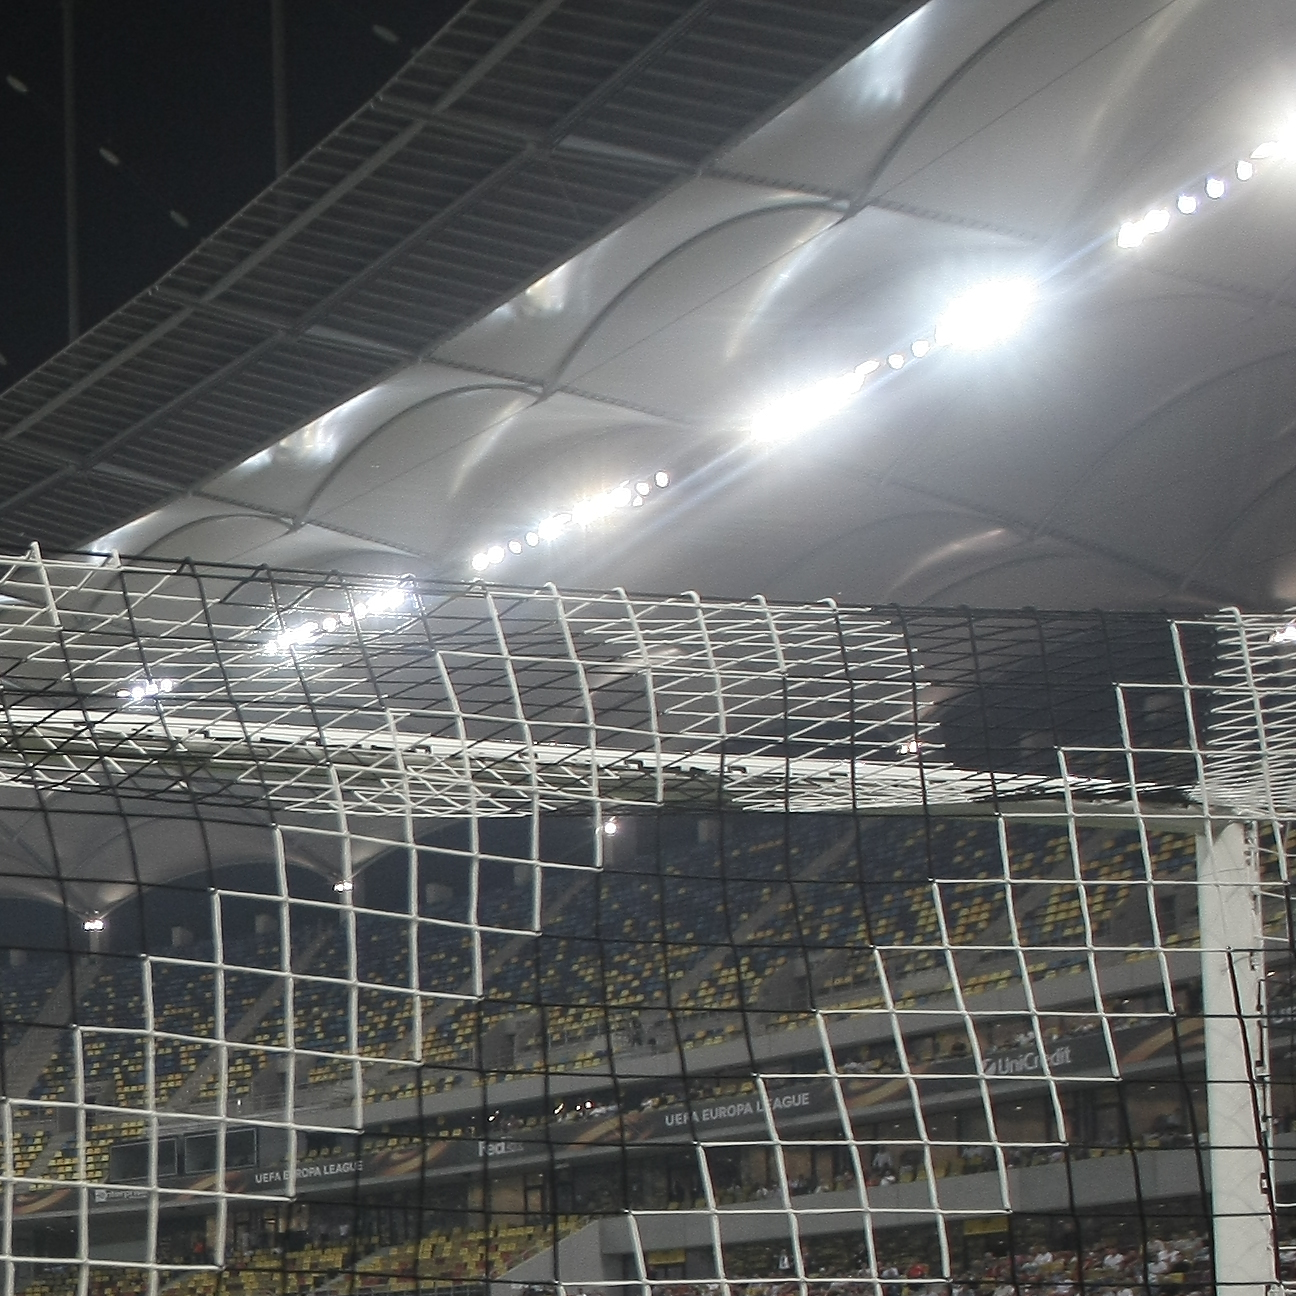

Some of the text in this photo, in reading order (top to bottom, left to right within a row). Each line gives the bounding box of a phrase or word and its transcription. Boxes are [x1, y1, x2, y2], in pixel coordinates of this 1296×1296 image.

[998, 1046, 1071, 1075] UniCrdit
[702, 1103, 753, 1121] EUROPA
[756, 1093, 810, 1112] LAGUE
[255, 1172, 281, 1183] UEFA
[283, 1166, 322, 1180] EROPA
